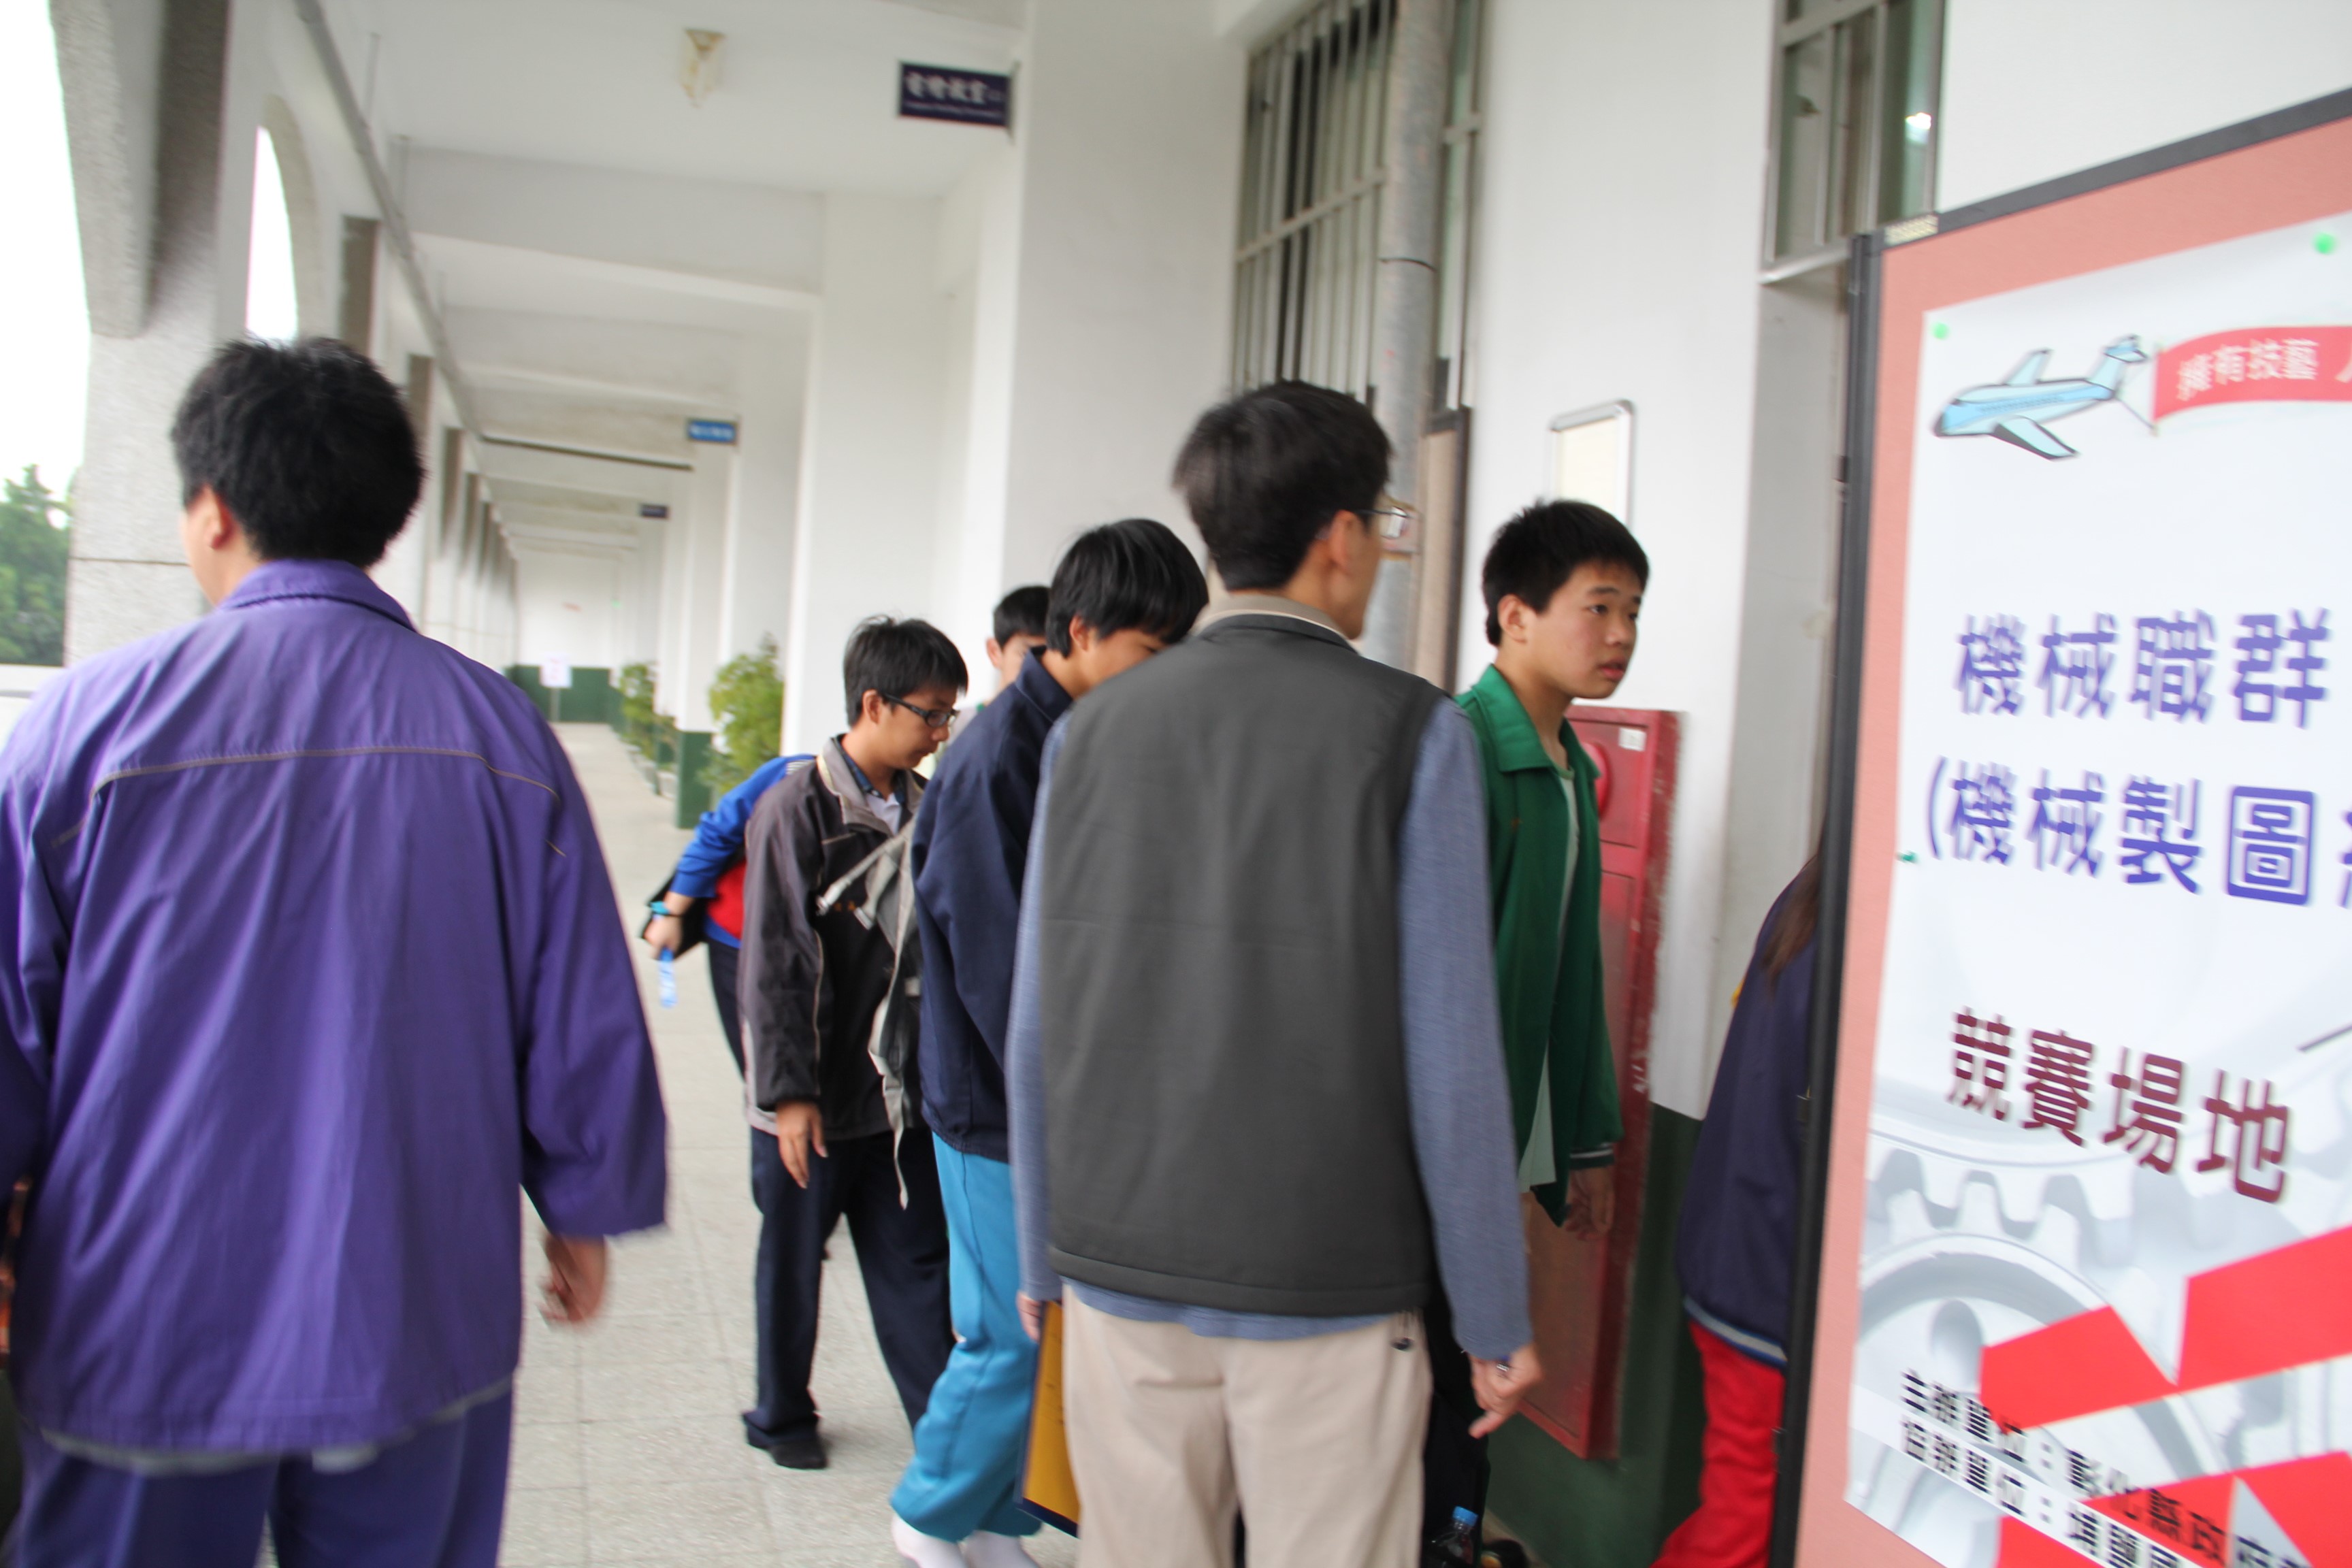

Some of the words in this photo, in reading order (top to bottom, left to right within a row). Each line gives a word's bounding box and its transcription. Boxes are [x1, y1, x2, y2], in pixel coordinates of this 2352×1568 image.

[1955, 608, 2330, 729] 機械職群
[1928, 755, 2352, 910] (機械製圖
[1948, 1005, 2289, 1203] 競賽場地
